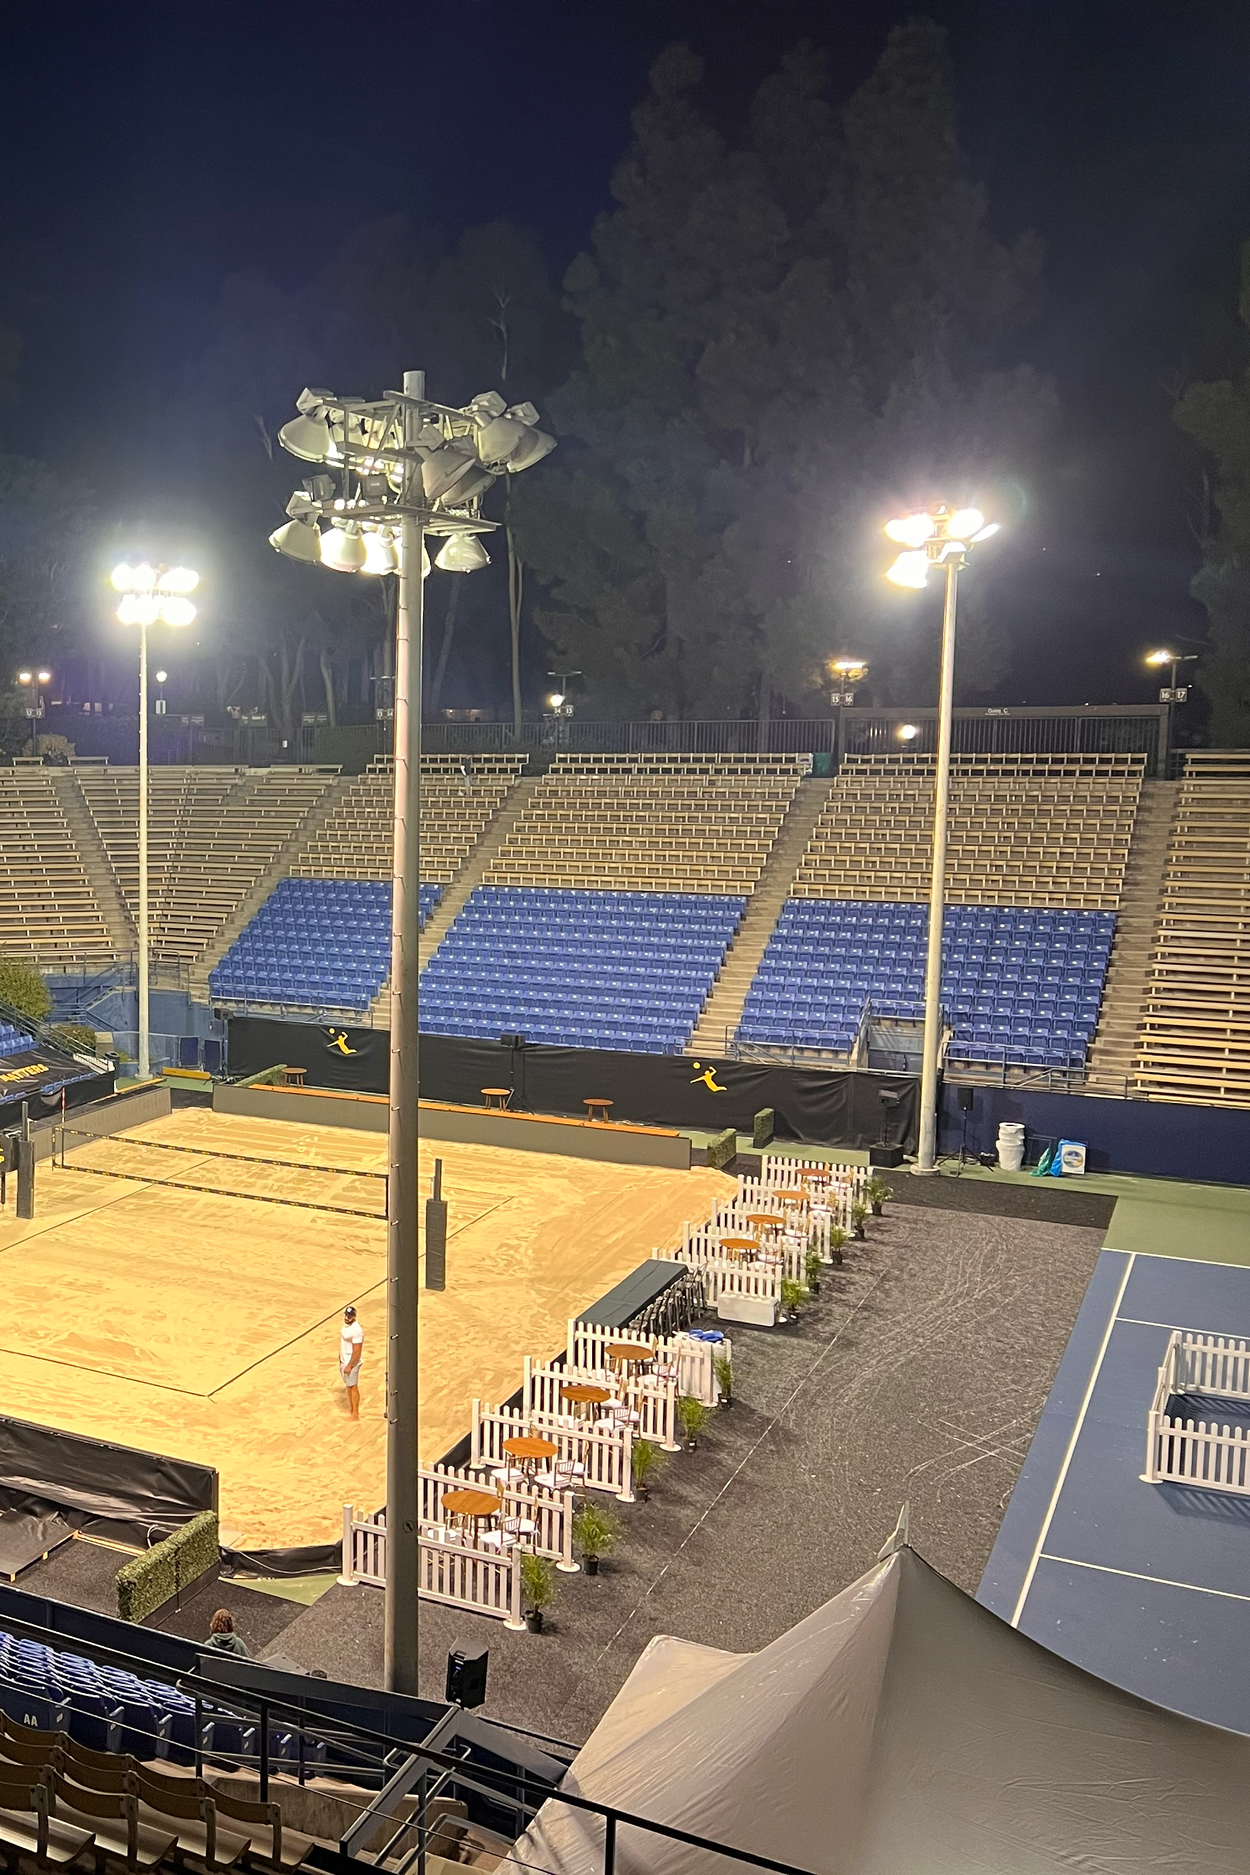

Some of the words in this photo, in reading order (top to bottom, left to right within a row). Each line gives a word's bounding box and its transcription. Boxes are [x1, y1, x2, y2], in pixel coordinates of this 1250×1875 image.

[1161, 691, 1170, 699] 16
[1177, 691, 1186, 699] 17
[23, 1713, 38, 1727] AA
